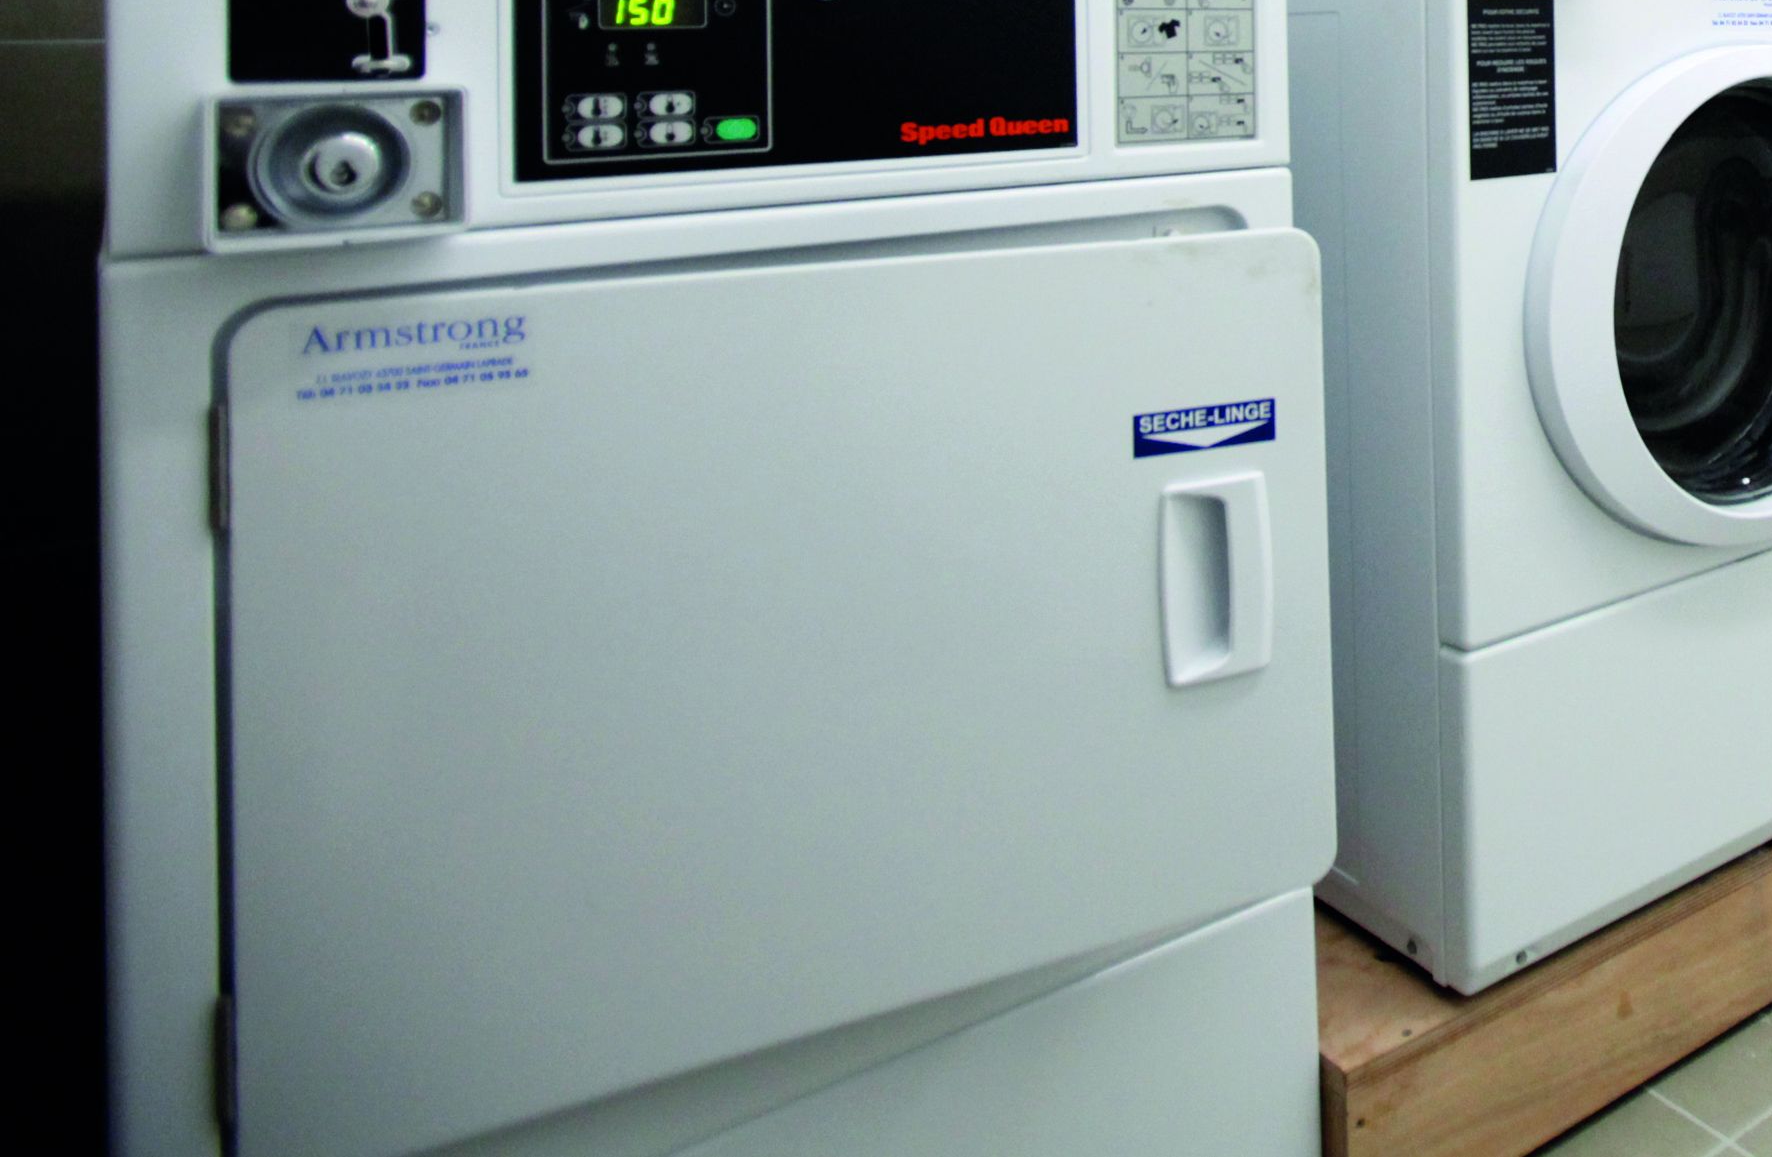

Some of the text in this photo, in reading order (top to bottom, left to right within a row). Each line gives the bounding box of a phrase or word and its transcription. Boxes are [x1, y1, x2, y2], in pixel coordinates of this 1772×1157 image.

[902, 116, 1071, 144] Speed Queen
[301, 315, 526, 354] Armstrong
[459, 340, 500, 350] FRANCE
[1139, 401, 1272, 434] SECHE-LINGE
